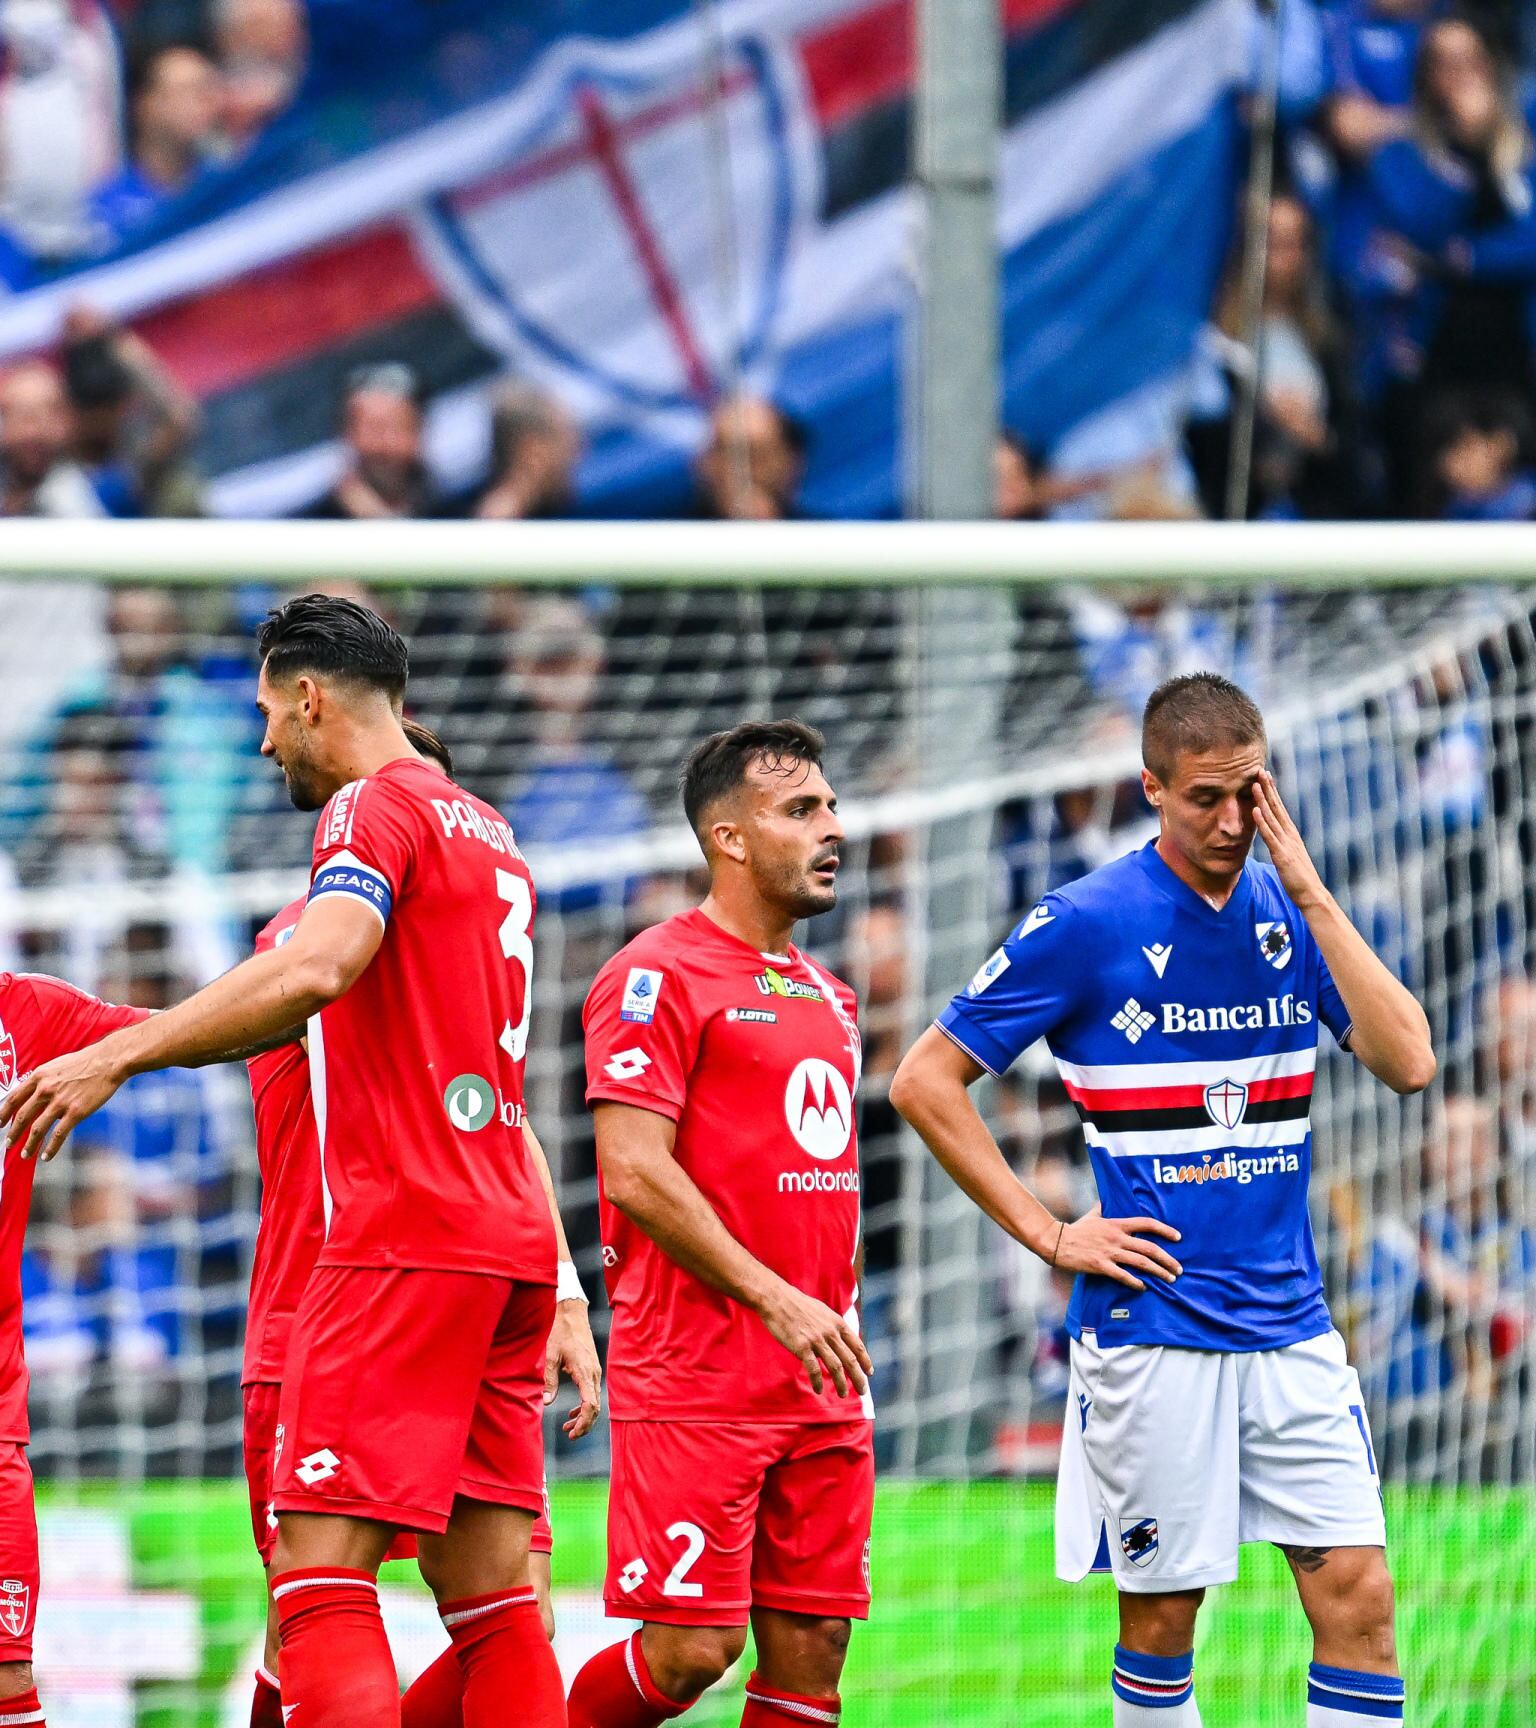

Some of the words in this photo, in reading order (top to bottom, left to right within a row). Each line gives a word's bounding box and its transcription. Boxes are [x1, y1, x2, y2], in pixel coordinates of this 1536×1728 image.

[320, 873, 385, 902] PEACE
[495, 867, 534, 1064] 3
[738, 1009, 777, 1023] LOTTO
[1161, 1003, 1264, 1034] Banca
[1266, 994, 1313, 1027] Ifis
[778, 1167, 860, 1193] motorola
[663, 1521, 706, 1598] 2
